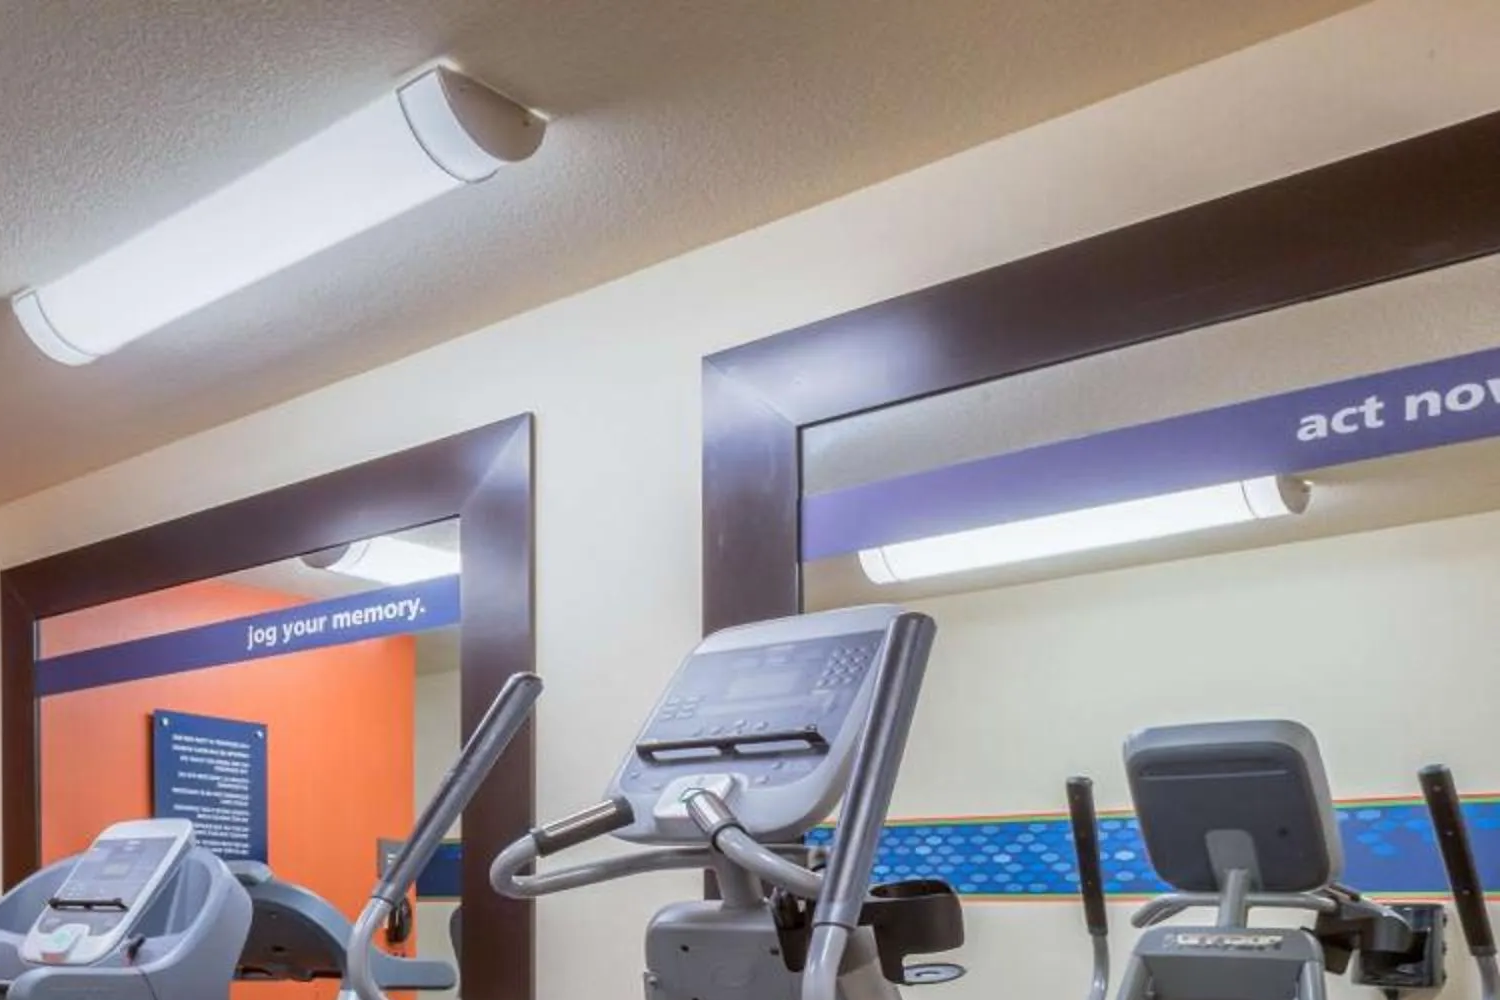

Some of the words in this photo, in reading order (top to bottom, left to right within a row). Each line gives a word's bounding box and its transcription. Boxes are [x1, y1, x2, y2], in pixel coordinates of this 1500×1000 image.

[1296, 395, 1385, 441] act
[1405, 378, 1500, 421] no
[247, 625, 277, 650] jog
[282, 614, 328, 643] your
[332, 598, 426, 629] memory.
